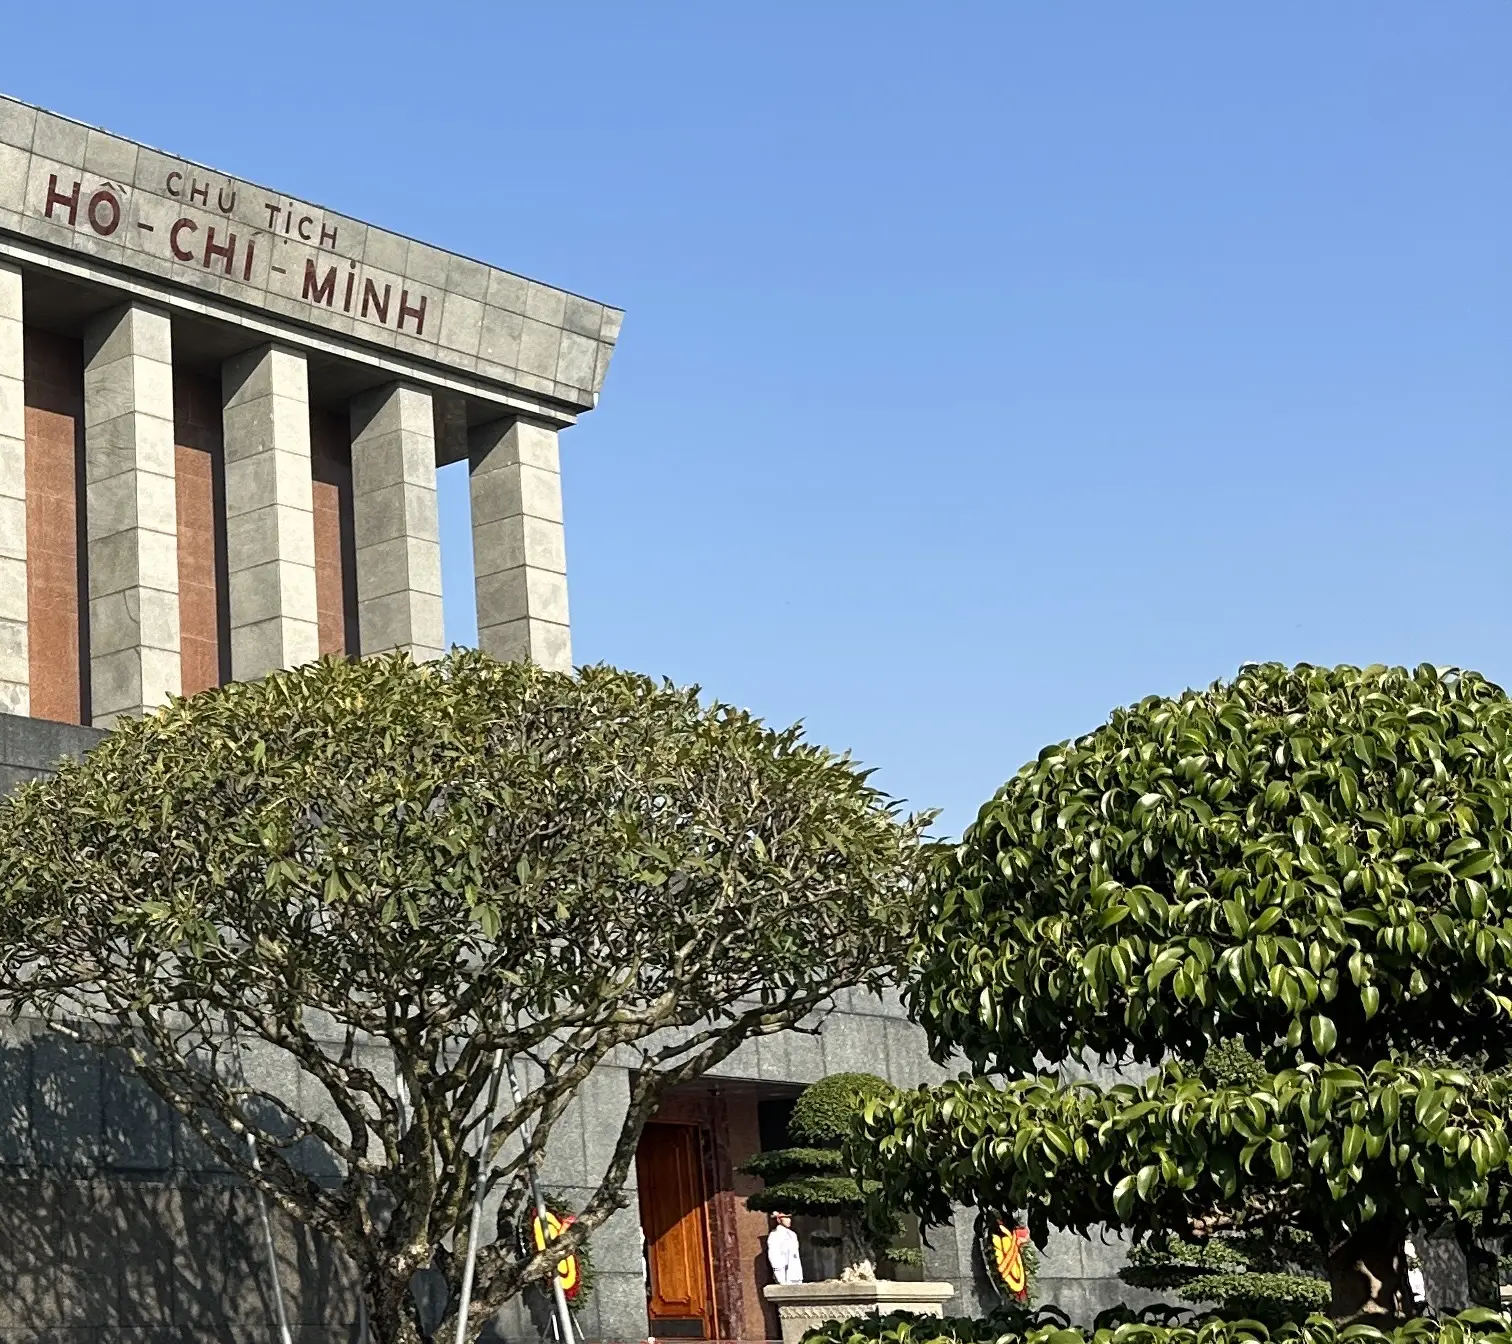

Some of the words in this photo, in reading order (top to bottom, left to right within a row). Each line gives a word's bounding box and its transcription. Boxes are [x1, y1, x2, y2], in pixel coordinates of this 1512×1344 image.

[44, 173, 127, 236] HỒ
[170, 217, 262, 282] CHÍ
[166, 171, 236, 214] CHỦ
[264, 201, 338, 250] TỊCH
